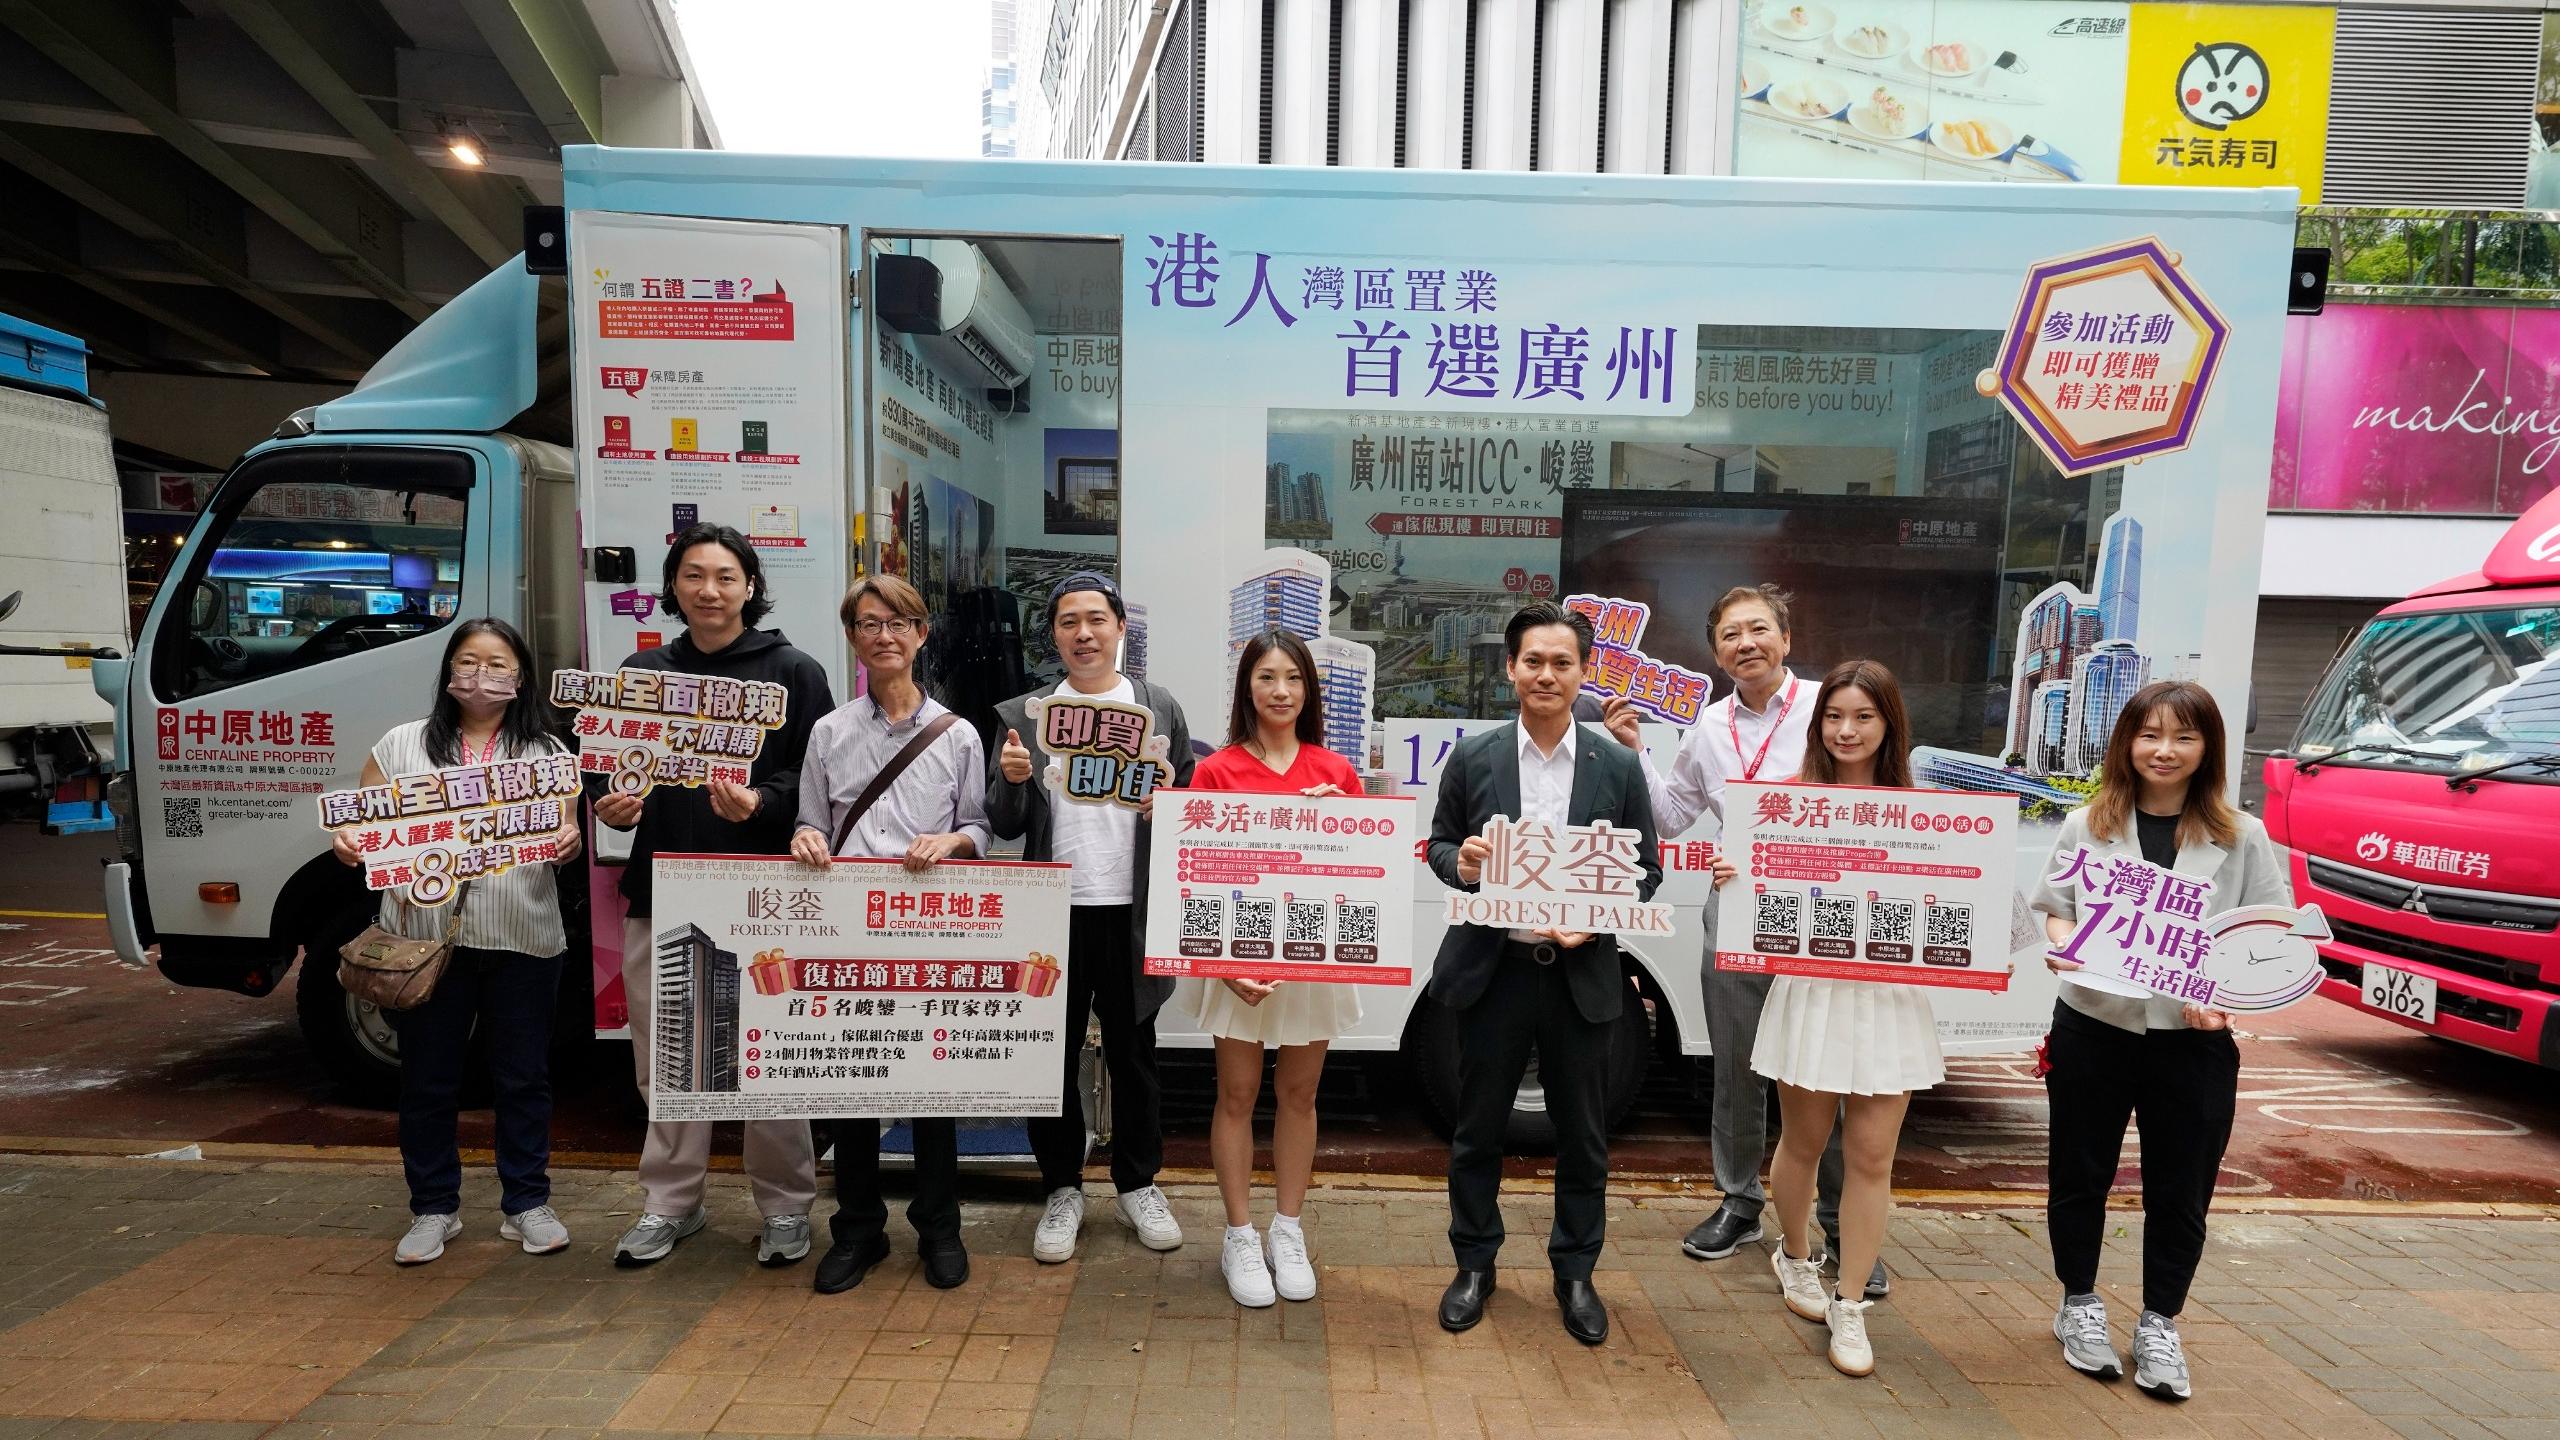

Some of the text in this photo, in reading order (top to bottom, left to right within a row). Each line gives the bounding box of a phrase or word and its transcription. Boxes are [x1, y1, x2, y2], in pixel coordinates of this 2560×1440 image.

[2076, 17, 2127, 34] 高速線
[2156, 137, 2278, 169] 元気寿司
[602, 281, 635, 299] 何謂
[2041, 310, 2174, 345] 參加活動
[1047, 337, 1119, 367] 中原地
[1336, 318, 1678, 404] 首選廣州
[2042, 350, 2161, 380] 即可獲贈
[607, 371, 640, 387] 五證
[650, 370, 705, 384] 保障房產
[1049, 369, 1118, 399] To buy
[1695, 386, 1894, 417] sks before you buy!
[2055, 382, 2169, 412] 精美禮品
[1401, 495, 1544, 510] FOREST PARK
[1481, 517, 1551, 537] 即買即住
[1912, 520, 1978, 537] 中原地產
[1506, 573, 1525, 587] B1
[1531, 579, 1551, 592] B2
[617, 598, 649, 613] 二書
[556, 671, 784, 726] 廣州全面撤辣
[184, 709, 336, 747] 中原地產
[576, 714, 761, 757] 港人置業 不限購
[1046, 703, 1147, 759] 即買
[185, 749, 335, 763] CENTALINE PROPERTY
[158, 764, 336, 776] 中原地產代理有限公司 牌照號碼 C-000227
[1068, 753, 1166, 802] 即住
[160, 779, 325, 794] 大灣區最新資訊及中原大灣區指數
[322, 755, 580, 828] 廣州全面撤辣
[207, 796, 292, 809] hk.centanet.com/
[1747, 791, 1992, 834] 樂活在廣州 快閃活動
[208, 809, 289, 820] greater-bay-area
[1174, 798, 1394, 836] 樂活在廣州 快閃活動
[357, 800, 561, 854] 港人置業 不限購
[1657, 840, 1714, 871] 九龍
[2392, 841, 2491, 879] 華盛証券
[656, 860, 780, 872] 中原地產代理有限公司
[831, 864, 883, 874] C-000227
[657, 870, 671, 879] To
[673, 871, 693, 881] buy
[709, 872, 726, 881] not
[728, 872, 740, 881] to
[741, 873, 760, 883] buy
[763, 873, 810, 883] non-local
[853, 875, 908, 887] properties?
[911, 877, 947, 885] Assess
[949, 877, 965, 886] the
[967, 878, 991, 887] risks
[992, 879, 1024, 888] before
[1026, 881, 1044, 890] you
[1046, 879, 1067, 889] buy!
[2050, 847, 2211, 922] 大灣區
[890, 891, 1004, 919] 中原地產
[1449, 895, 1673, 932] FOREST PARK
[730, 924, 840, 937] FOREST PARK
[866, 930, 935, 938] 中原地產代理有限公司
[889, 920, 1003, 931] CENTALINE PROPERTY
[2491, 920, 2535, 929] CANTER
[2048, 902, 2213, 970] 1小時
[1155, 960, 1192, 970] 中原地產
[1727, 954, 1767, 966] 中原地產
[2117, 955, 2217, 1005] 生活圈
[2385, 968, 2413, 996] VX
[2372, 985, 2425, 1019] 9102
[948, 1028, 1055, 1043] 全年高鐵來回車票
[764, 1046, 906, 1061] 24個月物業管理費全免
[948, 1046, 1014, 1060] 京東禮品卡
[764, 1065, 889, 1079] 全年酒店式管家服務
